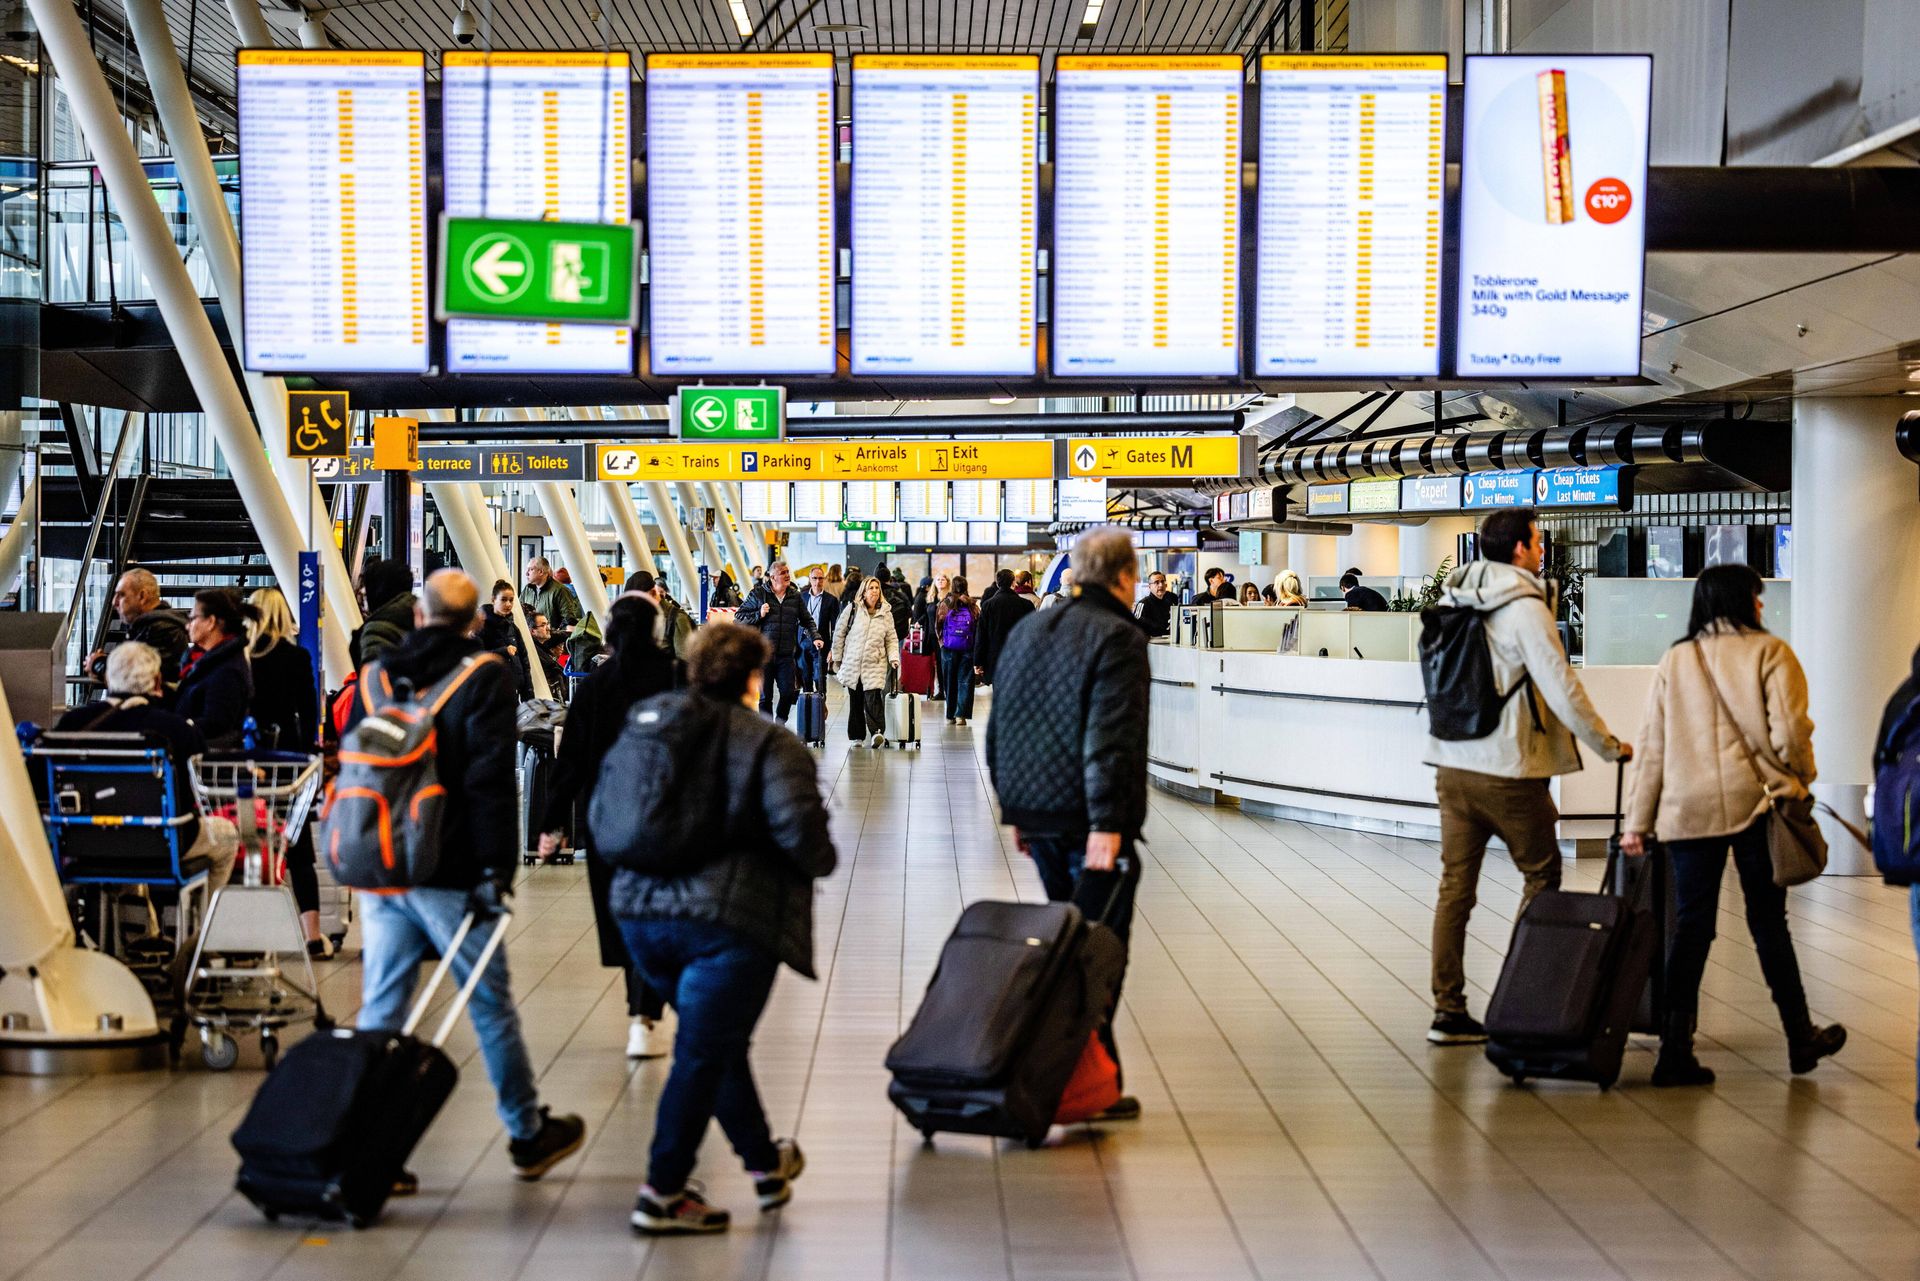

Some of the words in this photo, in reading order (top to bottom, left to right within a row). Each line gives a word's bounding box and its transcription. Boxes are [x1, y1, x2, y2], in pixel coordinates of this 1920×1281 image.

[1473, 275, 1538, 286] Toblerone
[1472, 290, 1499, 301] Milk
[1503, 290, 1533, 301] with
[1536, 289, 1567, 301] Gold
[1570, 290, 1629, 303] Message
[1472, 304, 1507, 317] 340g
[856, 446, 907, 459] Arrivals
[953, 446, 978, 459] Exit
[1127, 449, 1166, 463] Gates
[1171, 445, 1193, 468] M
[428, 457, 472, 470] terrace
[527, 456, 569, 469] Toilets
[682, 455, 720, 468] Trains
[763, 455, 811, 471] Parking
[856, 463, 898, 472] Aankomst
[953, 463, 988, 474] Uitgang
[1478, 477, 1496, 490] Cheap
[1498, 476, 1519, 487] Tickets
[1553, 473, 1574, 487] Cheap
[1575, 472, 1600, 484] Tickets
[1481, 494, 1494, 504] Last
[1495, 493, 1515, 504] Minute
[1557, 491, 1571, 502] Last
[1572, 490, 1596, 502] Minute
